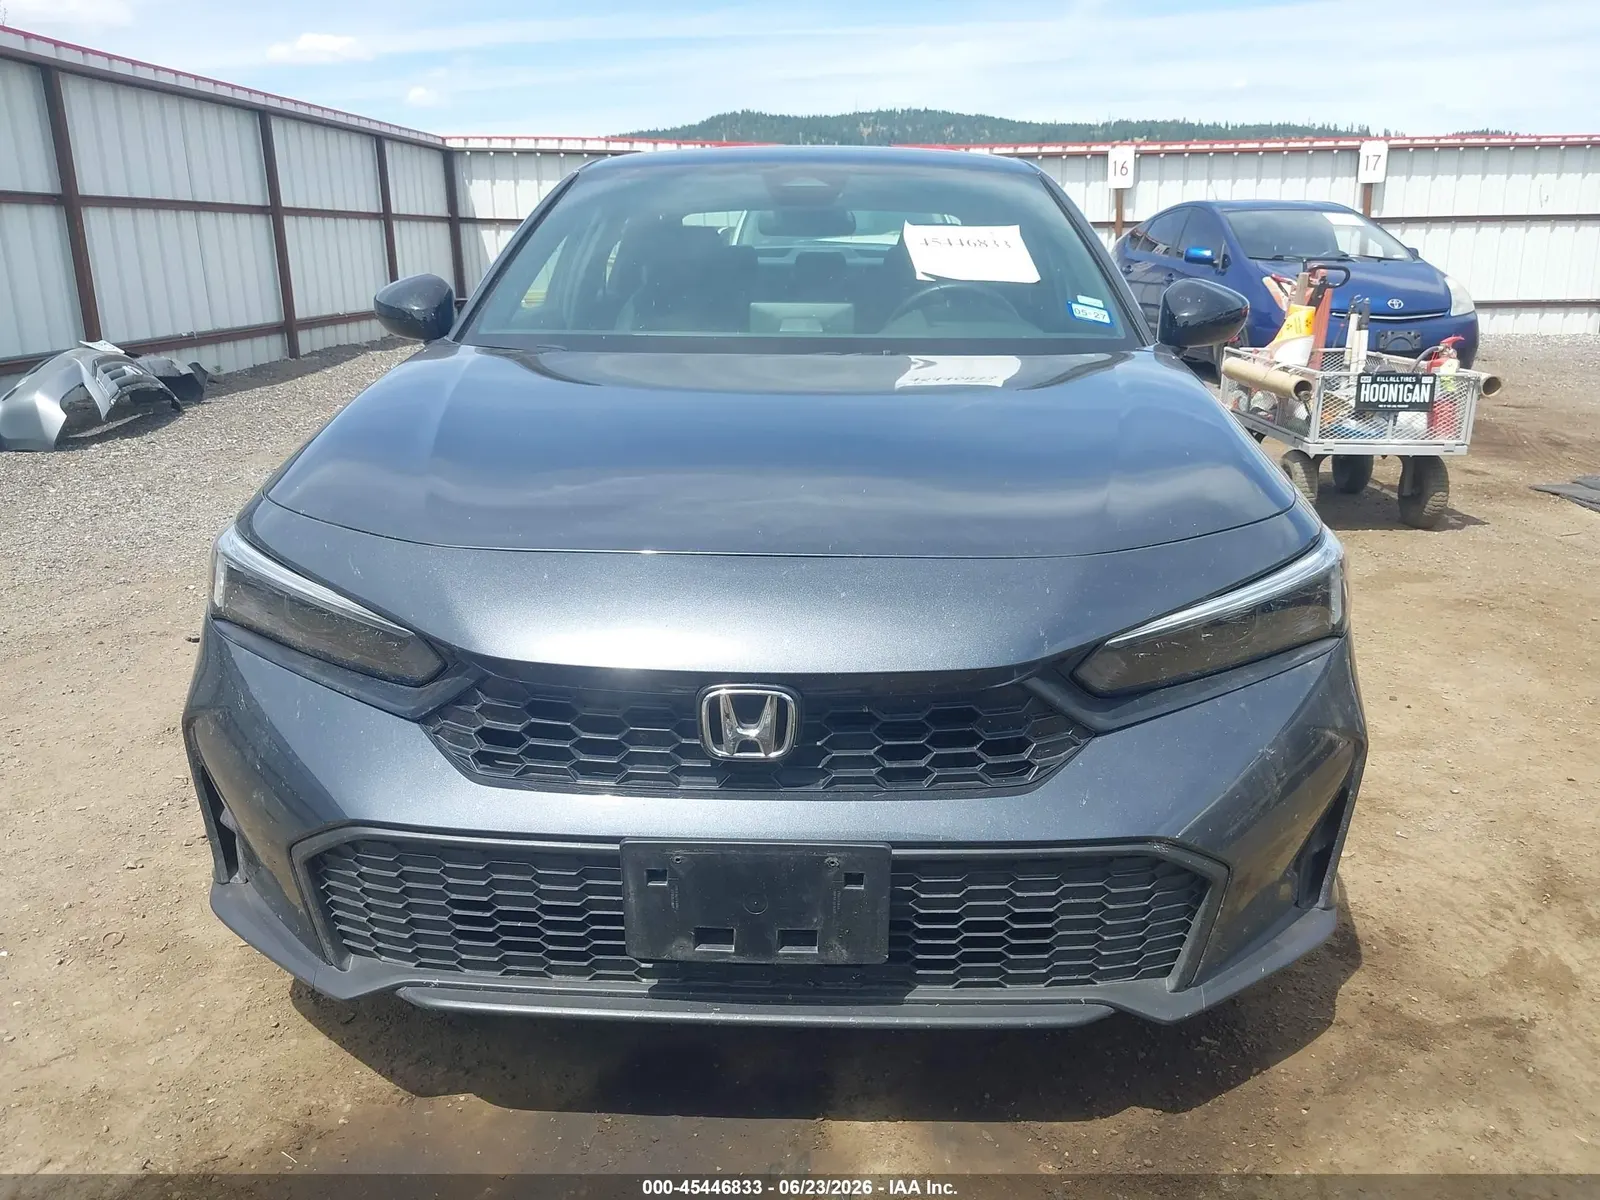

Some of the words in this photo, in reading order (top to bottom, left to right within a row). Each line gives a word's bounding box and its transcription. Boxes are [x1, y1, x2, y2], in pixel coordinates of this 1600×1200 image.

[1113, 160, 1128, 176] 16
[1365, 154, 1381, 171] 17
[1074, 307, 1106, 320] 05-27
